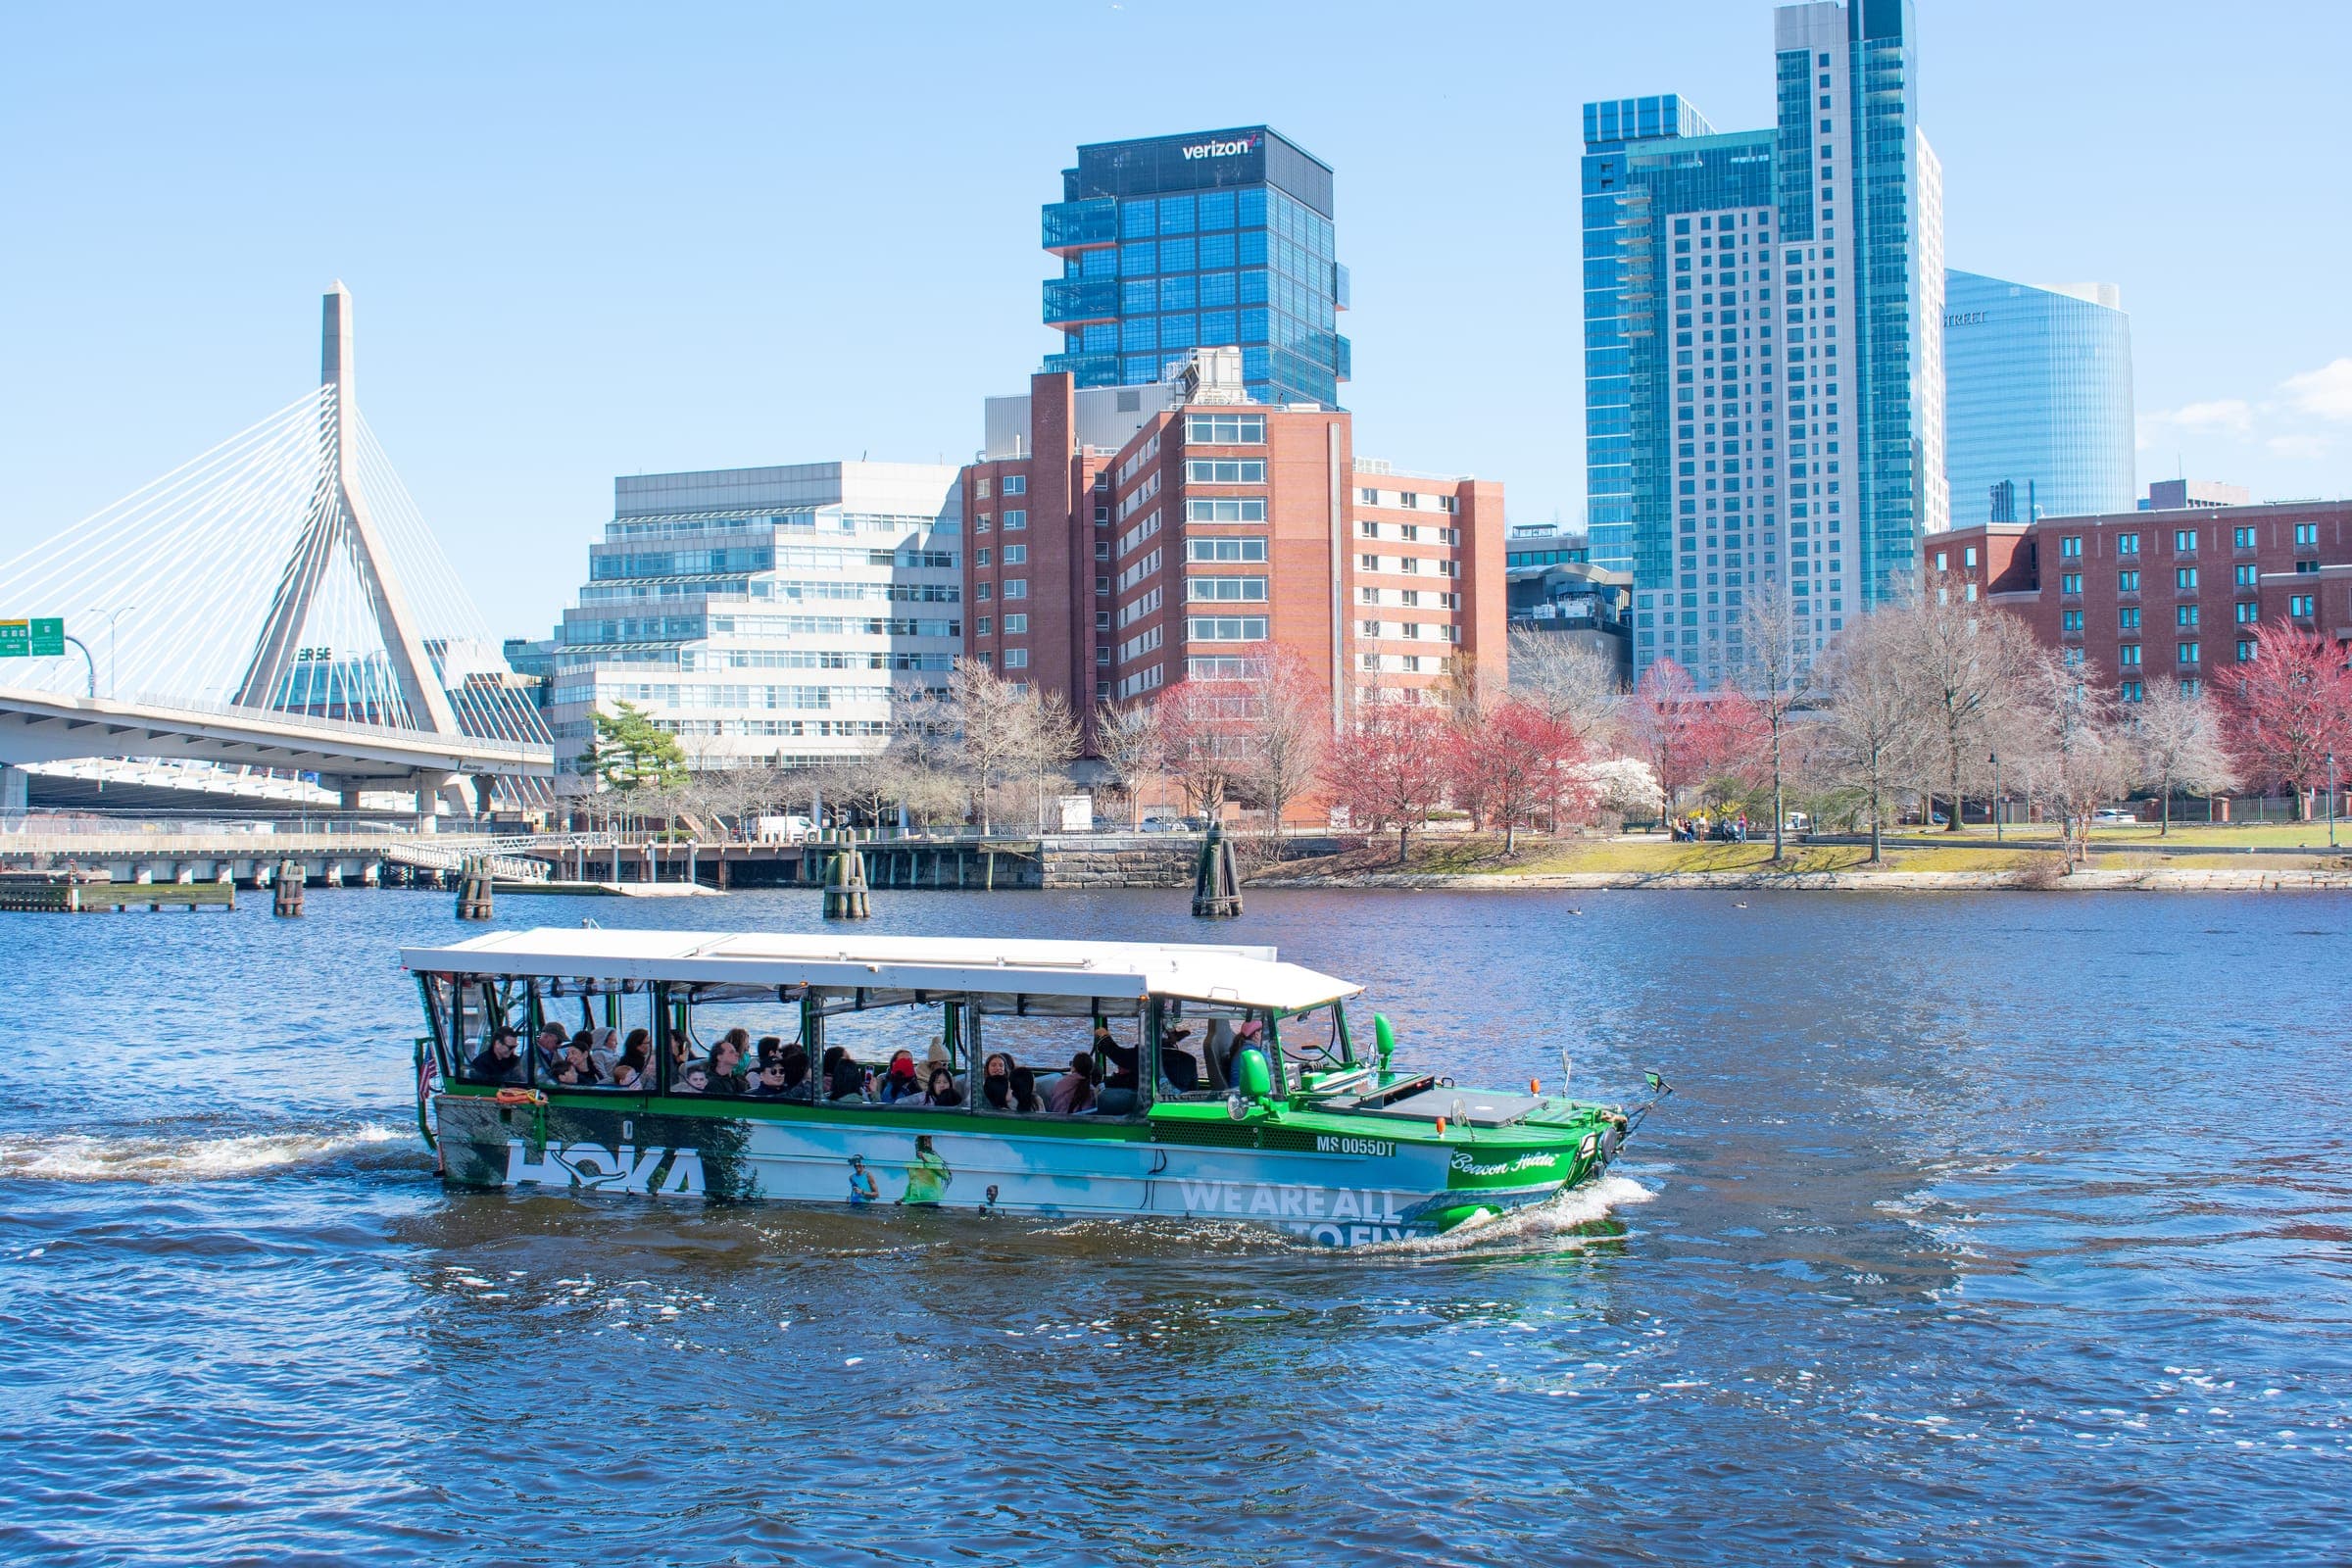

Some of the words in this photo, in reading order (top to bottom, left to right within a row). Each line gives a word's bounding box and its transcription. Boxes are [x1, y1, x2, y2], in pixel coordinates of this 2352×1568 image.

[1183, 140, 1249, 161] verizon
[1316, 1135, 1340, 1152] MS
[1342, 1138, 1396, 1157] 0055DT
[502, 1140, 707, 1199] HOKA
[1176, 1177, 1243, 1212] WE
[1248, 1182, 1325, 1217] ARE
[1331, 1187, 1403, 1224] ALL
